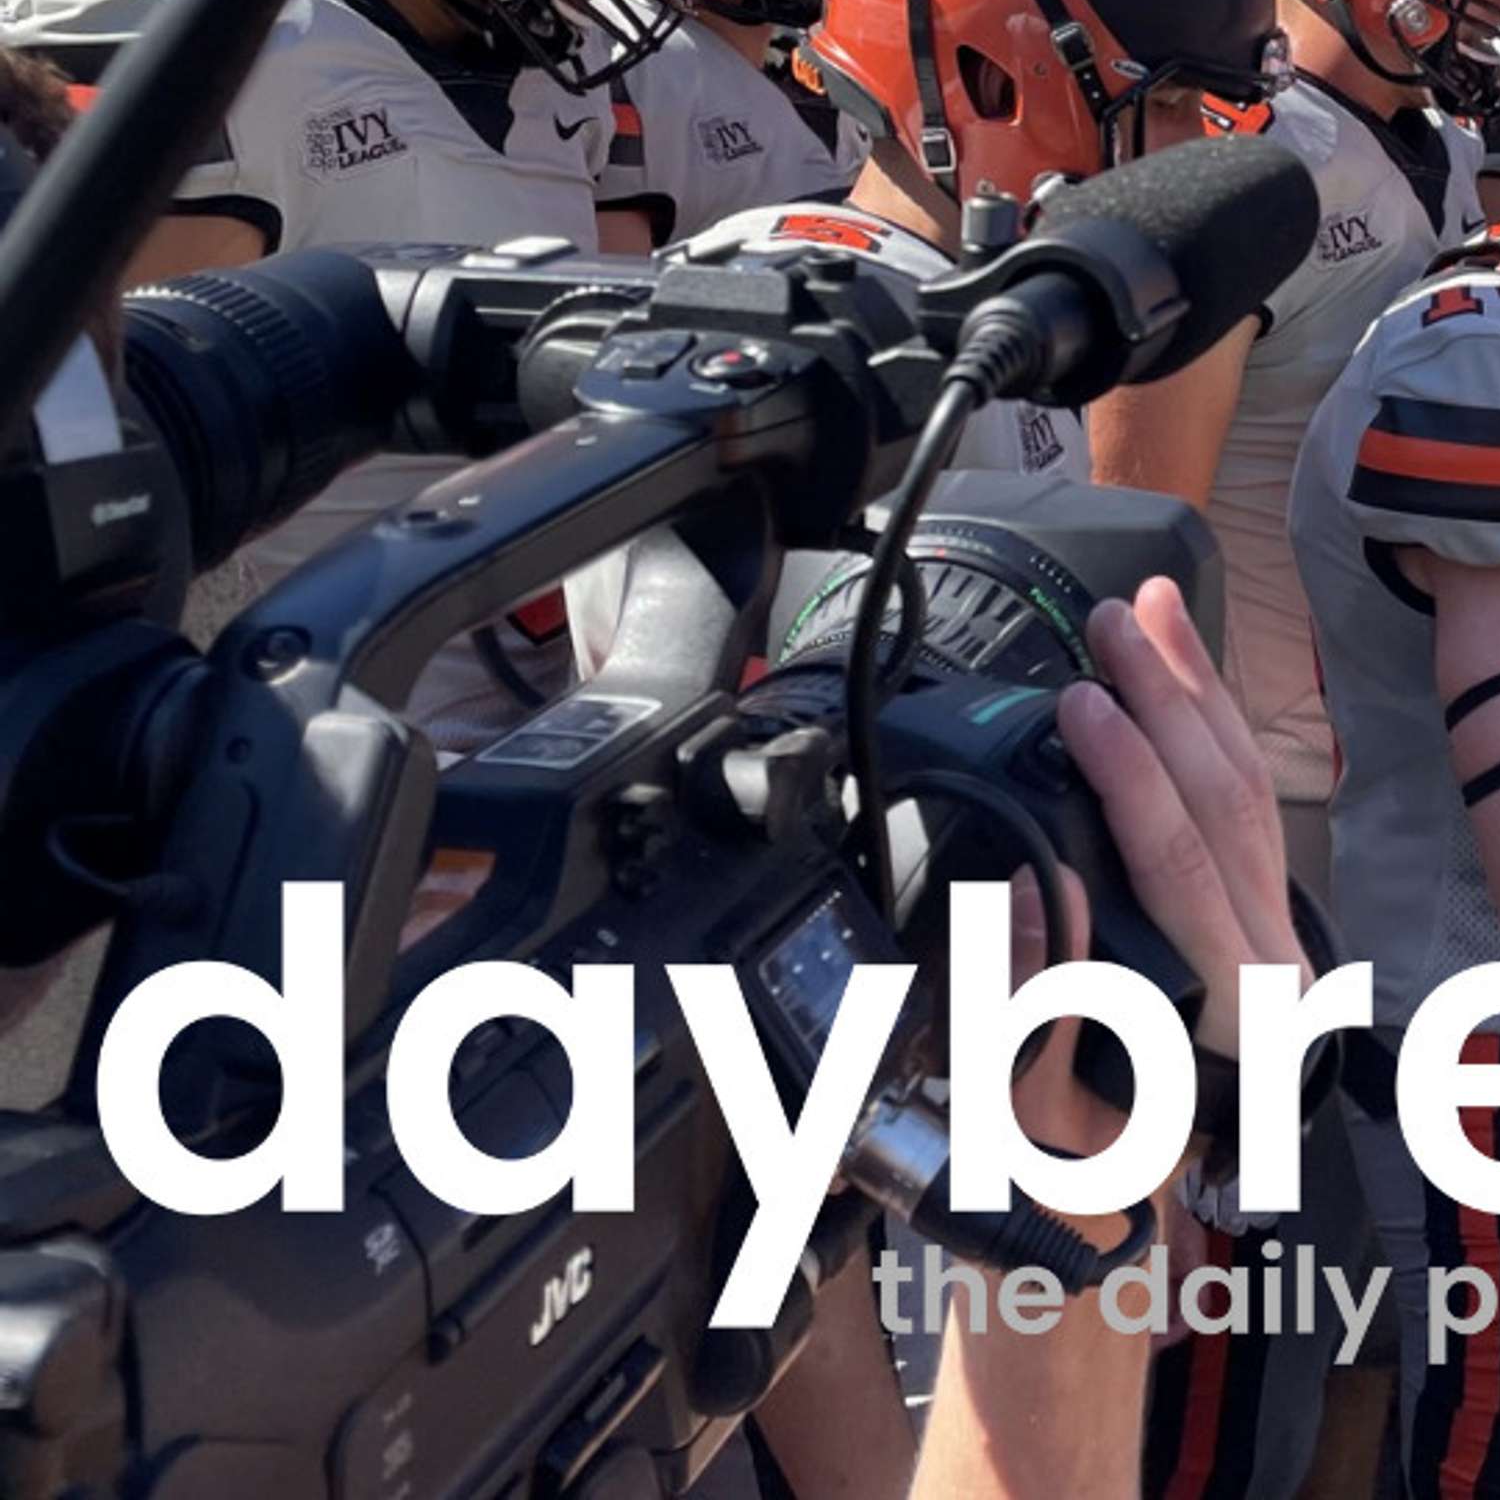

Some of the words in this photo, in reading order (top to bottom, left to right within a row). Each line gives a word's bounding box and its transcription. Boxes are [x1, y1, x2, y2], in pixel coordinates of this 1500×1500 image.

[332, 106, 393, 154] IVY
[1329, 213, 1371, 249] IVY
[530, 1246, 593, 1346] JVC
